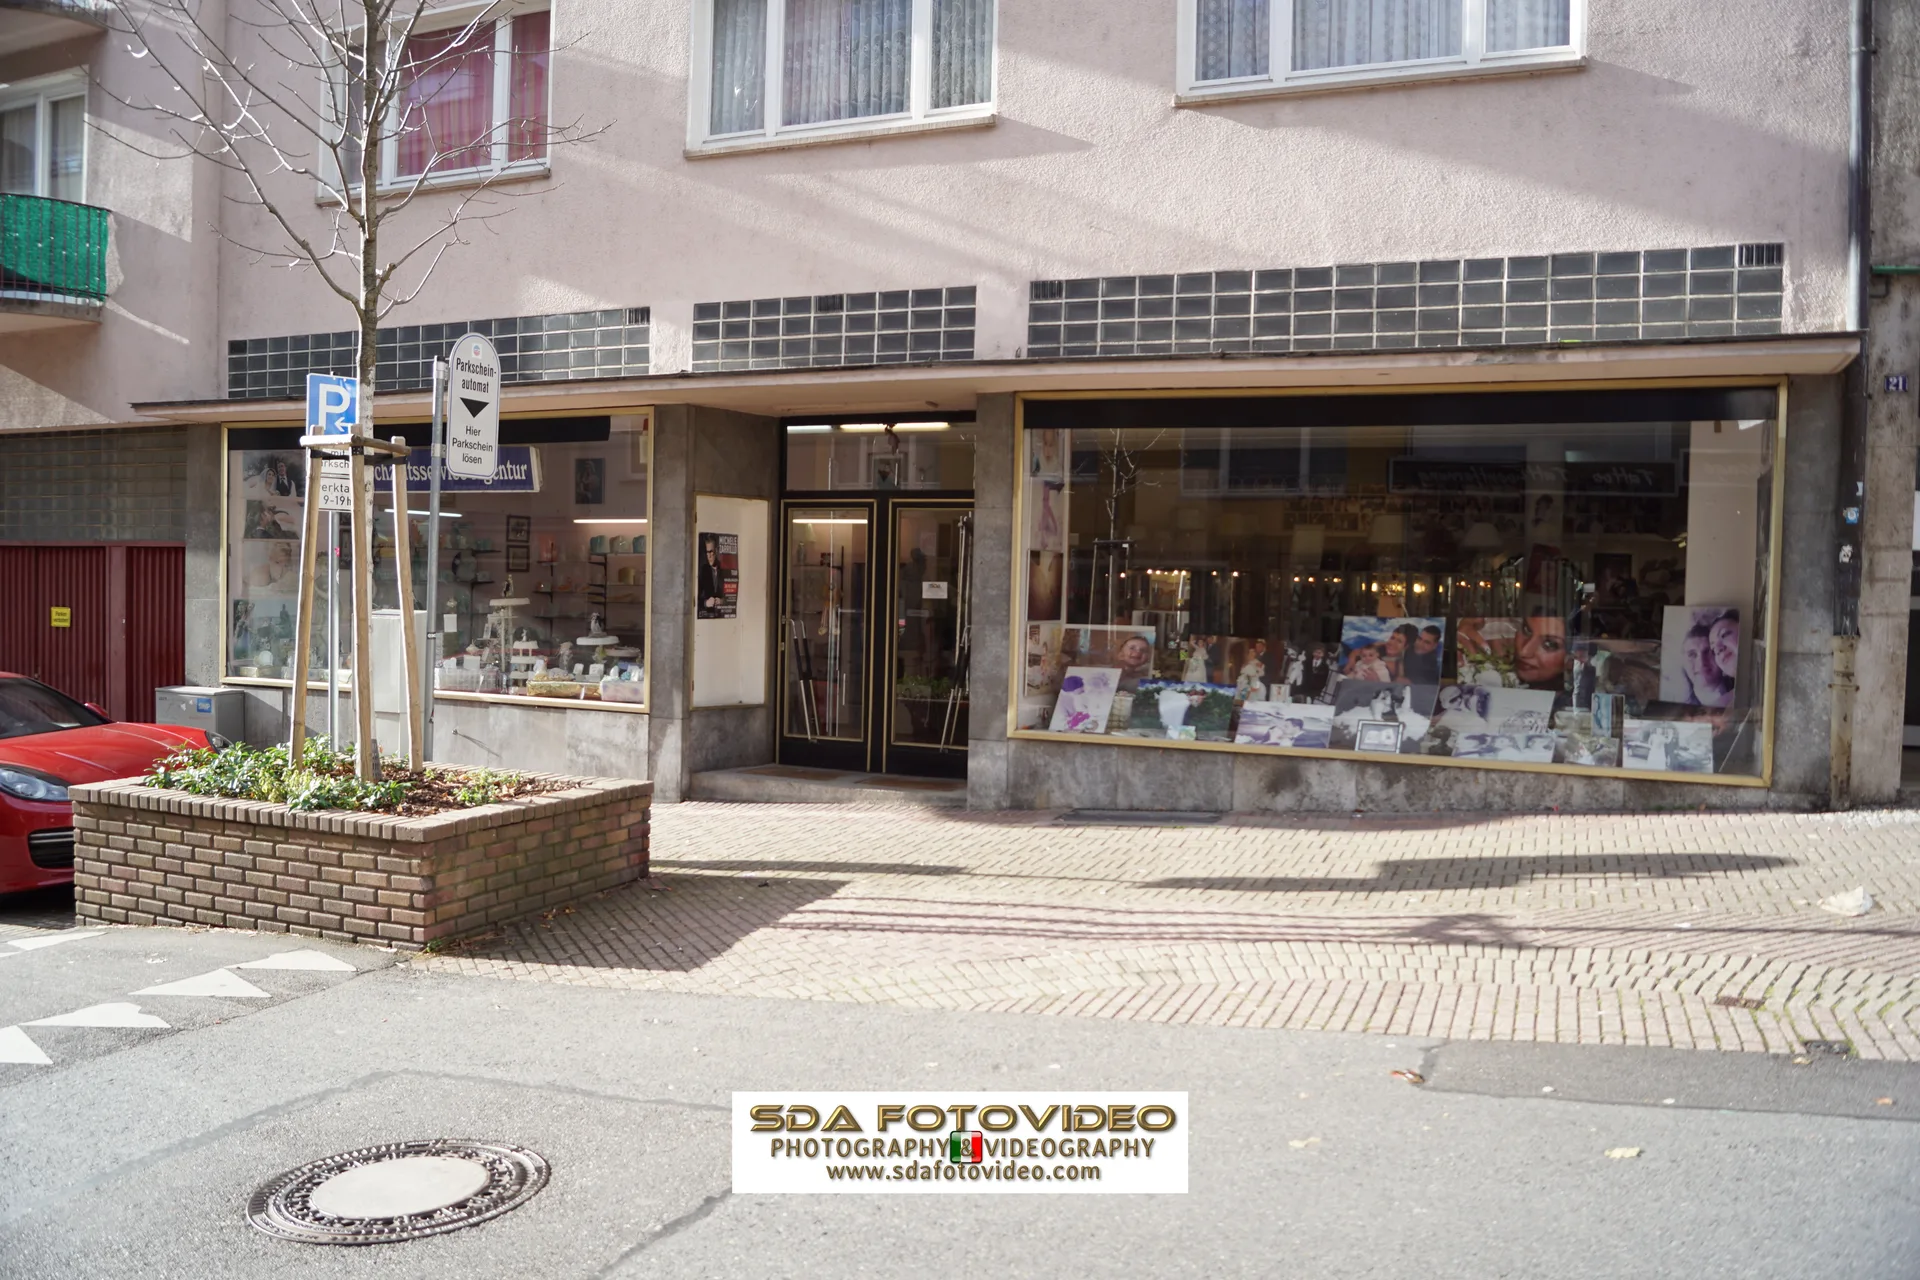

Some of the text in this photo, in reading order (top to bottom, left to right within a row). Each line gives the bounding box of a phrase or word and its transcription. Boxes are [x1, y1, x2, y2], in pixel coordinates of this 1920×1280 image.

[456, 358, 497, 378] Parkschein-
[462, 378, 489, 393] automat
[1889, 376, 1903, 391] 21
[318, 383, 351, 431] P
[465, 426, 481, 436] Hier
[452, 438, 493, 452] Parkschein
[462, 453, 482, 464] lösen
